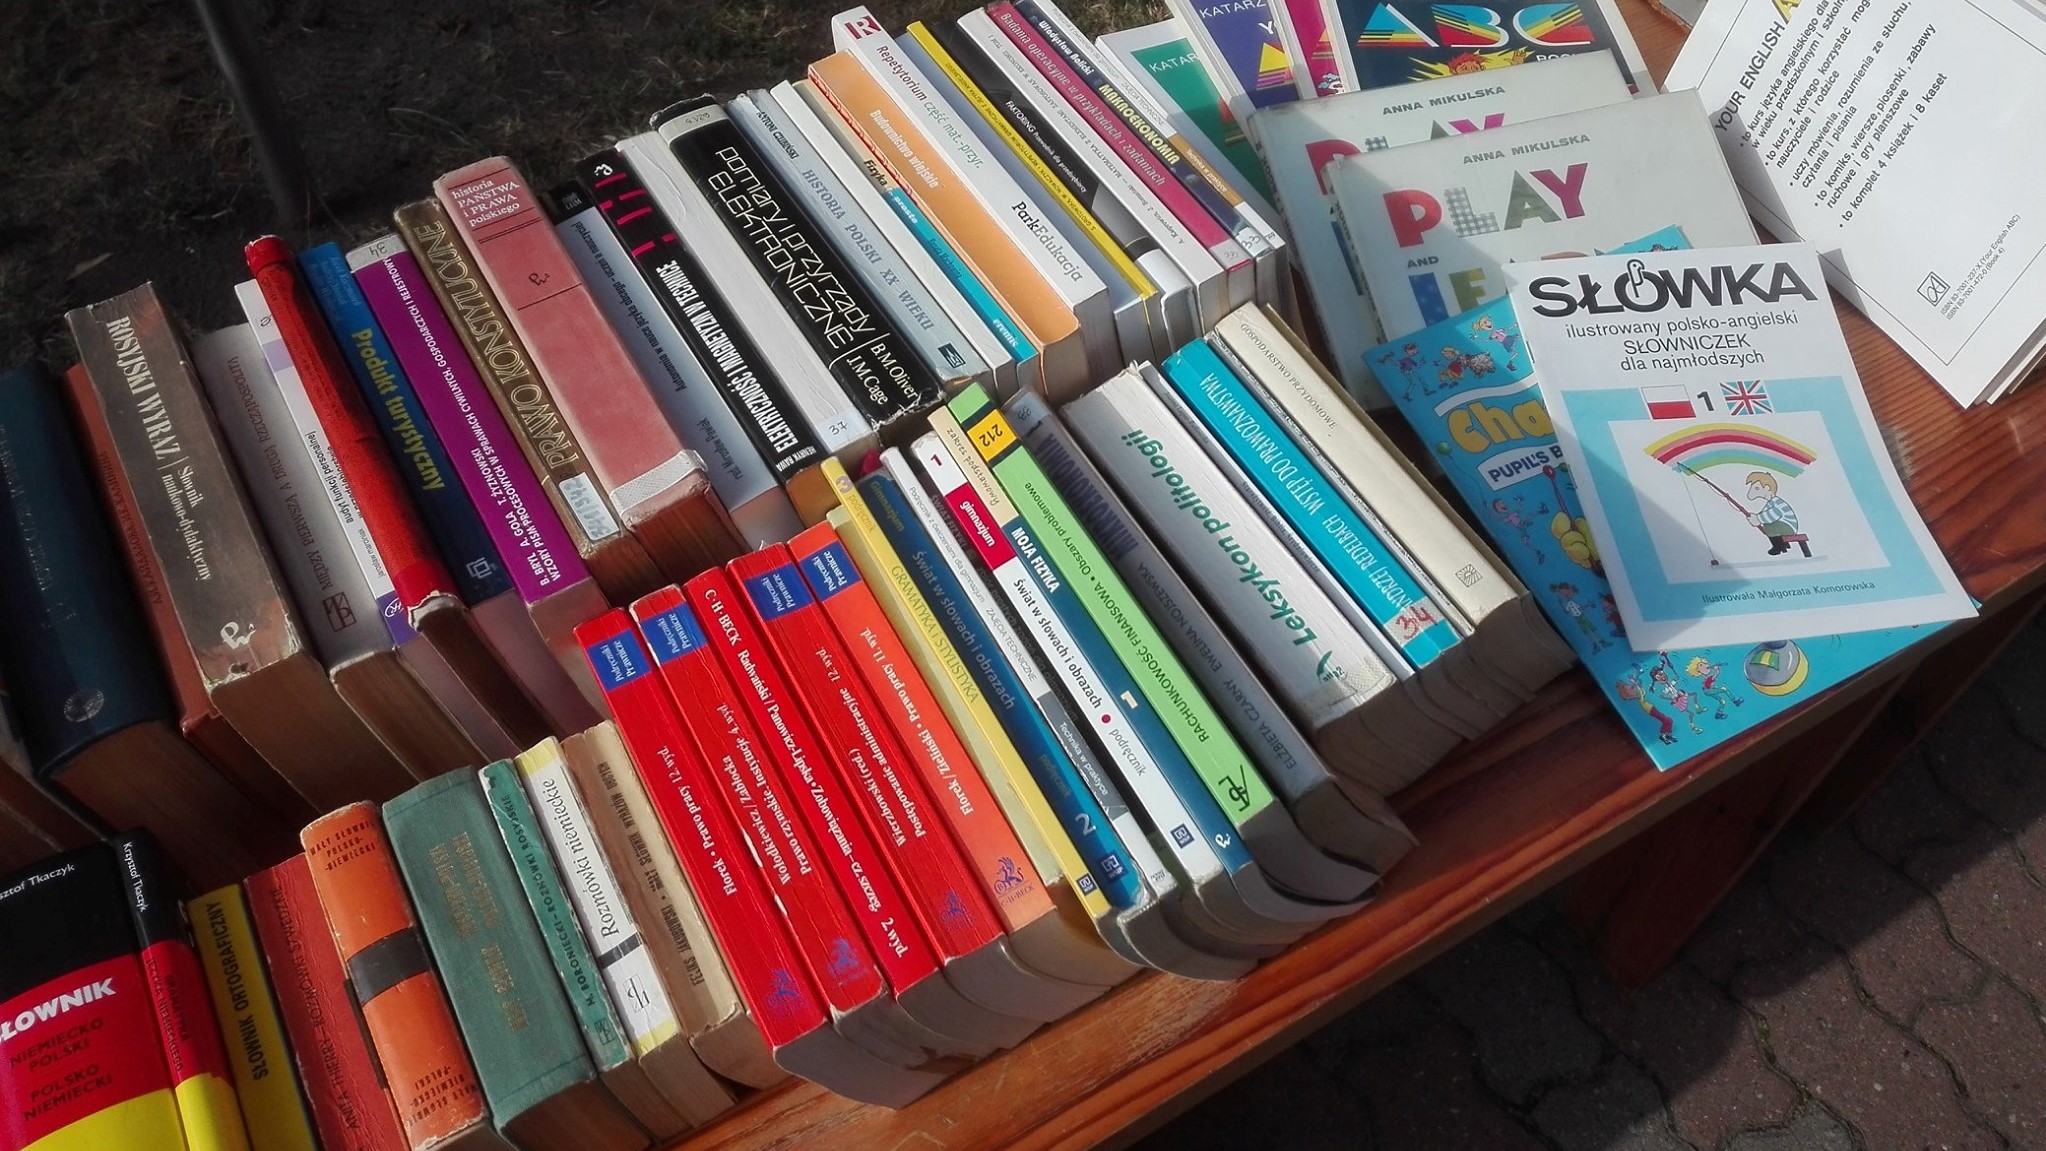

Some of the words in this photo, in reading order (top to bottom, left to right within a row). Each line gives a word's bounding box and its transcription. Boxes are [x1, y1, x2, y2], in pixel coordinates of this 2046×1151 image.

[999, 10, 1032, 45] Badania
[1025, 40, 1072, 88] operacyjne
[1121, 141, 1166, 187] zadaniach
[1714, 89, 1746, 133] YOUR
[1739, 20, 1785, 90] ENGLISH
[1746, 108, 1765, 131] kurs
[1760, 77, 1784, 110] języka
[1778, 16, 1820, 77] angielskiego
[1835, 53, 1874, 109] rozumienia
[874, 42, 928, 103] Repetytorium
[921, 98, 948, 126] część
[940, 121, 985, 170] mat.-przyr.
[1004, 99, 1036, 133] FAKTORING
[1069, 51, 1094, 76] Balicki
[1098, 81, 1180, 166] MAKROEKONOMIA
[1382, 102, 1424, 116] ANNA
[1429, 86, 1506, 108] MIKULSKA
[1756, 109, 1778, 138] wieku
[1774, 114, 1812, 169] nauczyciele
[1812, 69, 1840, 106] rodzice
[1463, 150, 1505, 165] ANNA
[1511, 134, 1590, 156] MIKULSKA
[1799, 147, 1831, 189] czytania
[1830, 104, 1858, 141] pisania
[1825, 167, 1856, 209] ruchowe
[1859, 141, 1876, 160] gry
[1870, 86, 1910, 140] planszowe
[451, 180, 494, 199] historia
[458, 181, 520, 208] PAŃSTWA
[861, 157, 889, 187] Fizyka
[469, 203, 520, 227] polskiego
[470, 193, 517, 215] PRAWA
[1383, 163, 1589, 248] PLAY
[705, 167, 855, 352] ELEKTRONICZNE
[714, 141, 790, 230] pomiary
[780, 226, 878, 341] przyrządy
[801, 167, 846, 220] HISTORIA
[843, 221, 881, 265] POLSKI
[879, 266, 899, 287] XX
[896, 288, 934, 332] WIEKU
[1007, 198, 1086, 284] ParkEdukacja
[1407, 256, 1439, 269] AND
[1990, 228, 2010, 250] English
[410, 214, 531, 388] KONSTYTUCYJNE
[657, 256, 699, 306] TECHNICE
[407, 303, 448, 368] GOSPODARCZYCH
[625, 303, 648, 329] języka
[640, 325, 659, 348] nauce
[691, 307, 744, 372] MAGNETYZM
[1565, 321, 1661, 339] ilustrowany
[1667, 310, 1799, 336] polsko-angielski
[1620, 355, 1647, 371] dla
[1652, 350, 1765, 374] najmłodszych
[1624, 334, 1751, 355] SŁOWNICZEK
[103, 314, 157, 396] ROSYJSKI
[134, 391, 181, 460] WYRAZ
[655, 352, 687, 394] Autonomia
[1238, 321, 1292, 379] GOSPODARSTWO
[1287, 375, 1337, 430] PRZYDOMOWE
[349, 324, 401, 397] Produkt
[378, 393, 448, 496] turystyczny
[506, 377, 581, 472] PRAWO
[727, 367, 798, 456] ELEKTRYCZNOŚĆ
[1196, 371, 1285, 465] PRAWOZNAWSTWA
[1697, 391, 1714, 412] 1
[303, 430, 334, 475] personalnej
[464, 411, 495, 456] SPRAWACH
[979, 424, 1003, 446] 212
[176, 464, 205, 508] Słownik
[263, 444, 287, 480] DRUGĄ
[469, 446, 503, 498] ŻYZNOWSKI
[945, 426, 969, 456] zakres
[962, 454, 1001, 506] podstawowy
[1118, 419, 1231, 545] politologii
[1270, 454, 1298, 482] DO
[323, 474, 345, 501] funkcji
[336, 500, 354, 524] audyt
[492, 463, 532, 526] PROCESOWYCH
[1021, 480, 1066, 538] problemowe
[1285, 469, 1330, 516] WSTĘP
[157, 471, 214, 584] naukowo-dydaktyczny
[284, 493, 316, 546] PIERWSZĄ
[503, 510, 524, 537] GOLA
[525, 525, 544, 548] PISM
[958, 498, 998, 548] gimnazjum
[1321, 511, 1378, 572] REDELBACH
[307, 548, 334, 590] MIĘDZY
[524, 551, 545, 576] BRYL
[536, 546, 561, 580] WZORY
[821, 550, 848, 585] Prawnicze
[1010, 525, 1038, 558] MOJA
[1030, 554, 1061, 593] FIZYKA
[1059, 534, 1094, 576] Obszary
[1091, 581, 1142, 647] FINANSOWA
[1210, 528, 1321, 653] Leksykon
[1702, 592, 1755, 604] Ilustrowała
[1757, 588, 1811, 600] Małgorzata
[1813, 581, 1876, 594] Komorowska
[667, 611, 693, 648] Prawnicze
[889, 564, 937, 633] GRAMATYKA
[934, 636, 980, 703] STYLISTYKA
[911, 548, 941, 584] Świat
[939, 595, 978, 646] słowach
[973, 649, 1017, 709] obrazach
[881, 660, 906, 691] pracy
[1012, 576, 1039, 607] Świat
[1067, 660, 1104, 709] obrazach
[1108, 726, 1148, 777] podręcznik
[1134, 643, 1211, 744] RACHUNKOWOŚĆ
[1222, 676, 1261, 722] CZARNY
[836, 685, 889, 766] administracyjne
[896, 688, 921, 722] Prawo
[732, 735, 769, 786] Instytucje
[917, 728, 950, 775] Zieliński
[1057, 721, 1084, 755] Technika
[1082, 761, 1110, 796] praktyce
[677, 782, 701, 814] pracy
[719, 754, 753, 803] Zabłocka
[736, 648, 771, 701] Radwański
[883, 928, 909, 959] wyd.
[880, 764, 928, 837] Postępowanie
[946, 778, 974, 815] Florek
[500, 793, 531, 850] ROSYJSKIE
[539, 777, 584, 855] niemieckie
[689, 812, 714, 849] Prawo
[862, 777, 908, 846] Wierzbowski
[120, 842, 140, 879] Krzysztof
[746, 808, 793, 884] Wołodkiewicz
[786, 838, 812, 874] Prawo
[27, 863, 75, 887] Tkaczyk
[129, 879, 149, 912] Tkaczyk
[572, 855, 620, 938] Rozmówki
[711, 856, 737, 895] Florek
[659, 904, 690, 953] JAKUBOWSKI
[203, 899, 250, 1011] ORTOGRAFICZNY
[553, 920, 590, 991] BORONIECKI
[682, 955, 705, 986] FELIKS
[0, 977, 117, 1044] ŁOWNIK
[10, 1018, 104, 1067] NIEMIECKO
[29, 1037, 90, 1072] POLSKI
[237, 1014, 269, 1080] SŁOWNIK
